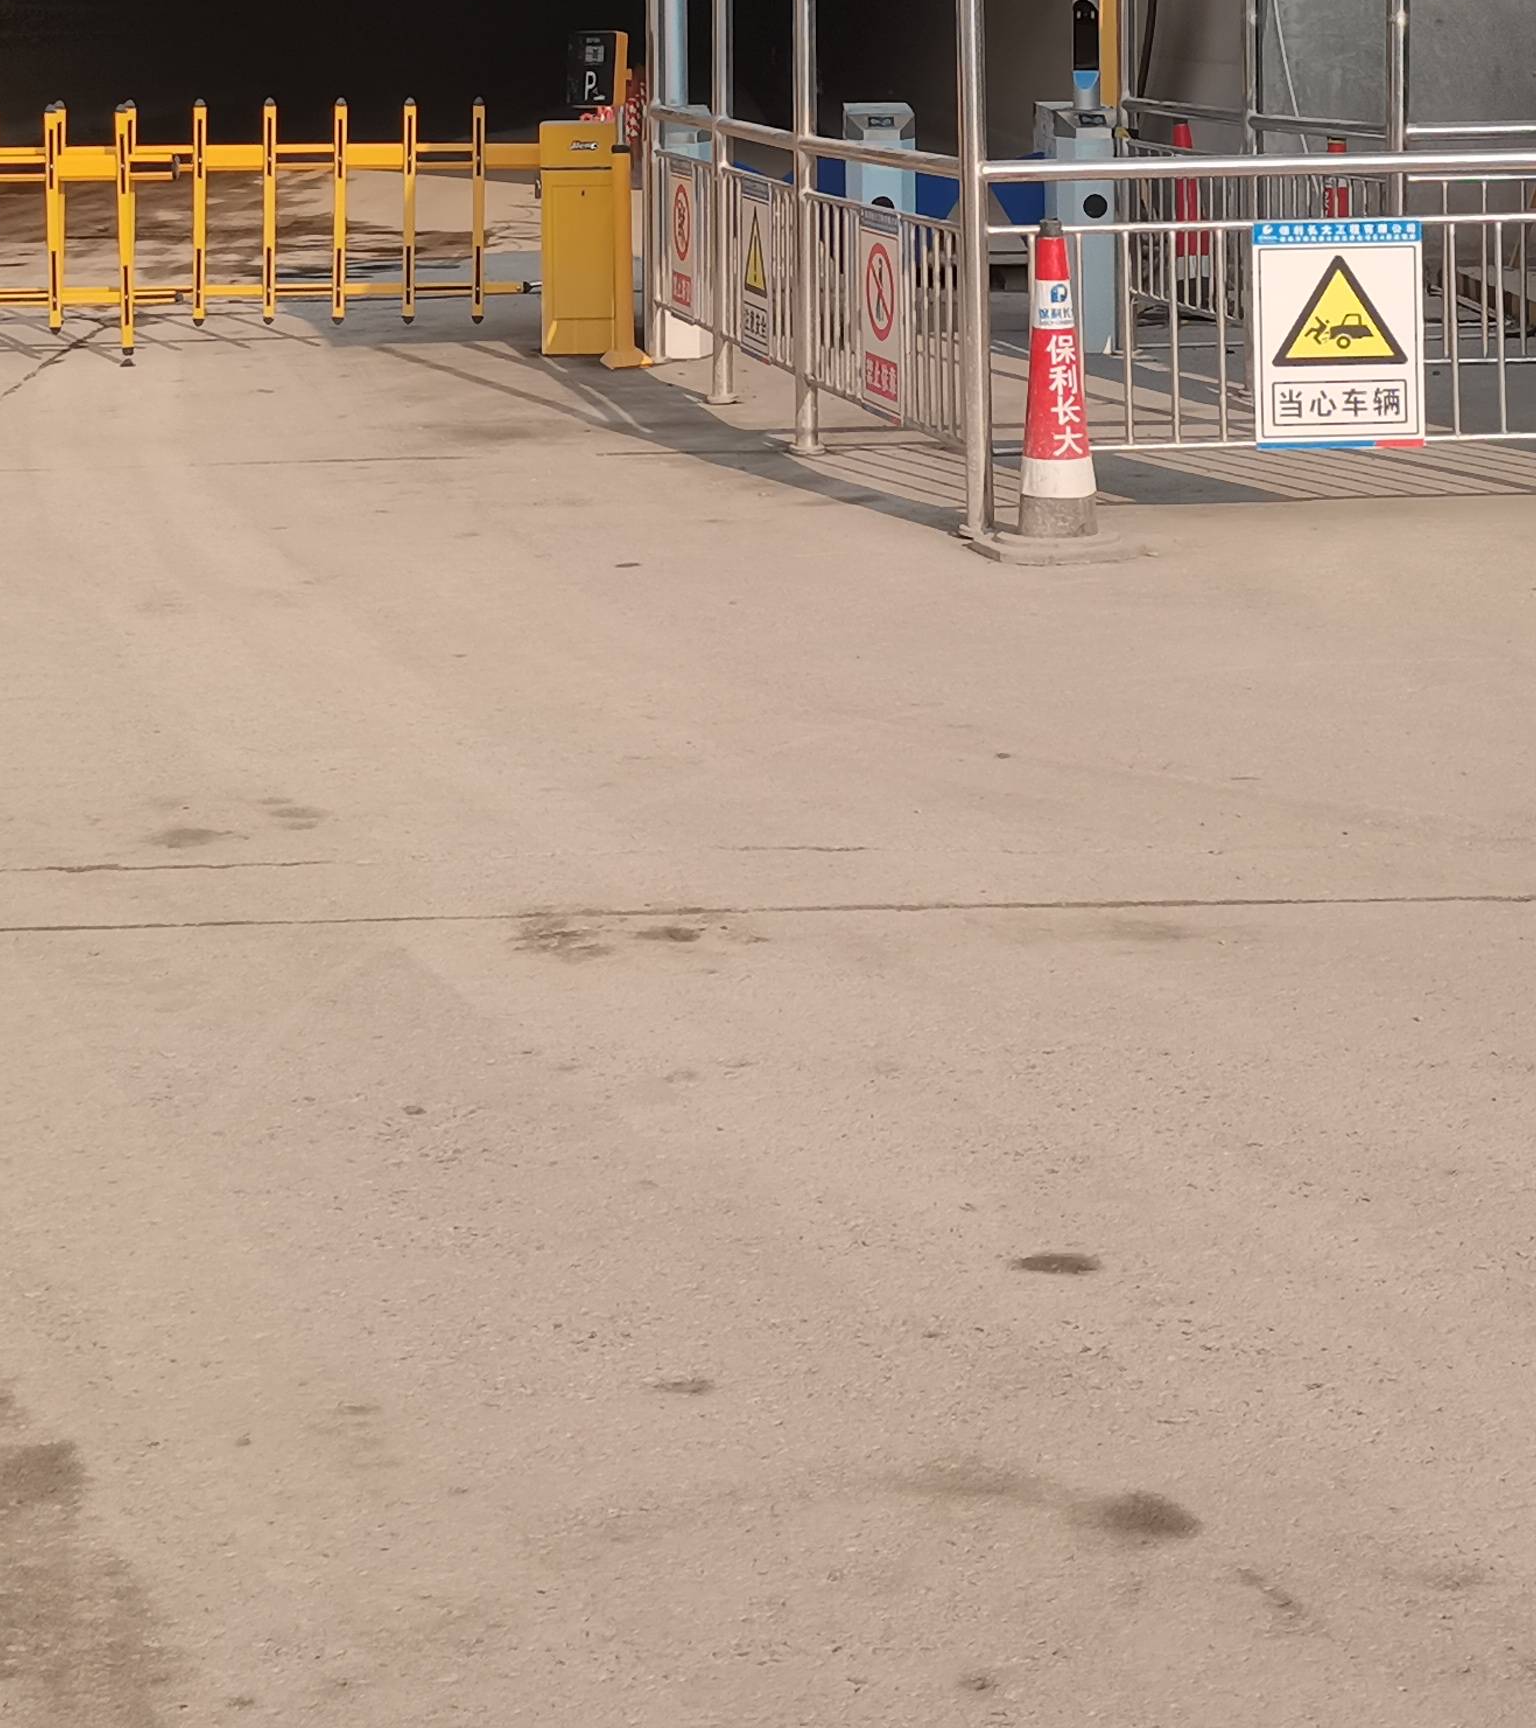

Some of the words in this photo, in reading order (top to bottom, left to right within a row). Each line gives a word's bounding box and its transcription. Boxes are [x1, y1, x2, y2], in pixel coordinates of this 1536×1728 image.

[1046, 334, 1083, 457] 保利长大
[1279, 387, 1401, 418] 当心车辆
